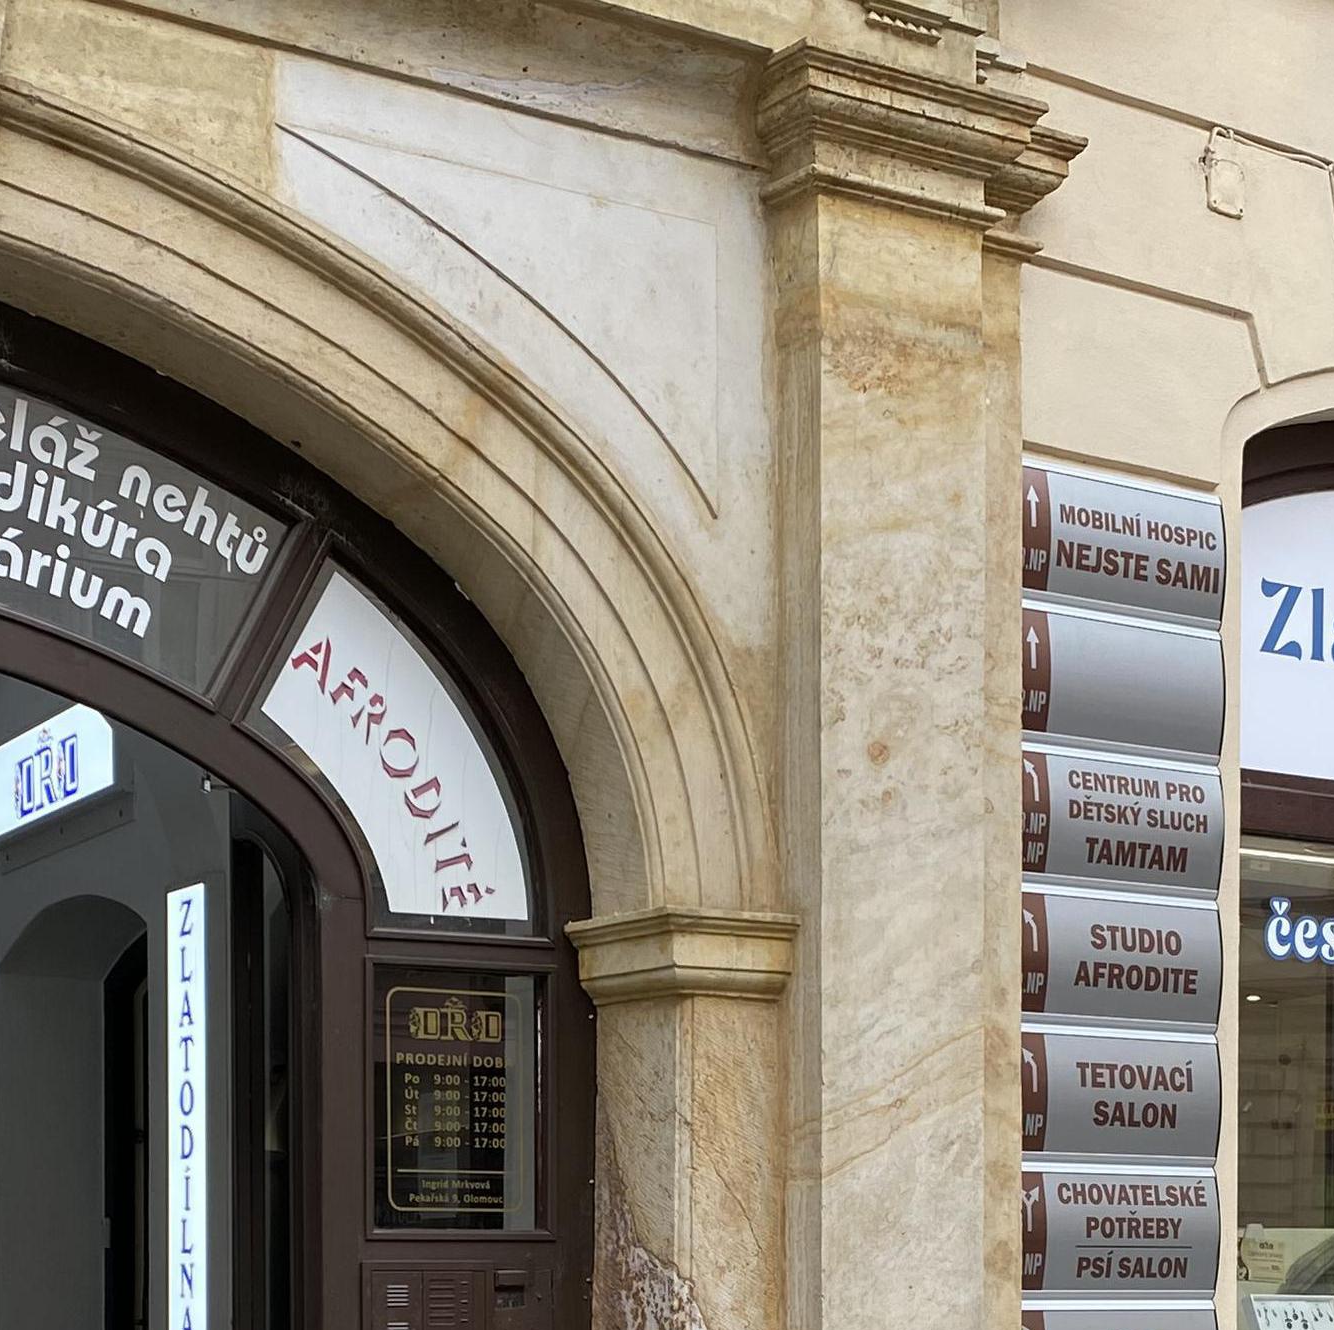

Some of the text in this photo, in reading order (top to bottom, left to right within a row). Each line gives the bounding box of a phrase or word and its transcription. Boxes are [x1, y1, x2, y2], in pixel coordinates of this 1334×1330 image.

[118, 464, 268, 575] nehtů
[1059, 502, 1217, 551] MOBILNÍ HOSPIC
[1056, 539, 1220, 594] NEJSTE SAMI
[1068, 769, 1206, 804] CENTRUM PRO
[1068, 795, 1209, 834] DĚTSKÝ SLUCH
[1085, 836, 1189, 873] TAMTAM
[1090, 923, 1183, 956] STUDIO
[1073, 961, 1199, 995] AFRODITE
[396, 1052, 468, 1067] PRODEJNÍ
[404, 1073, 506, 1087] Po 9:00 17:00
[1076, 1060, 1194, 1092] TETOVACÍ
[404, 1104, 418, 1116] St
[1093, 1100, 1177, 1129] SALON
[405, 1135, 420, 1147] Pá
[1057, 1180, 1208, 1207] CHOVATELSKÉ
[1085, 1210, 1183, 1240] POTŘEBY
[1076, 1251, 1189, 1279] PSÍ SALON
